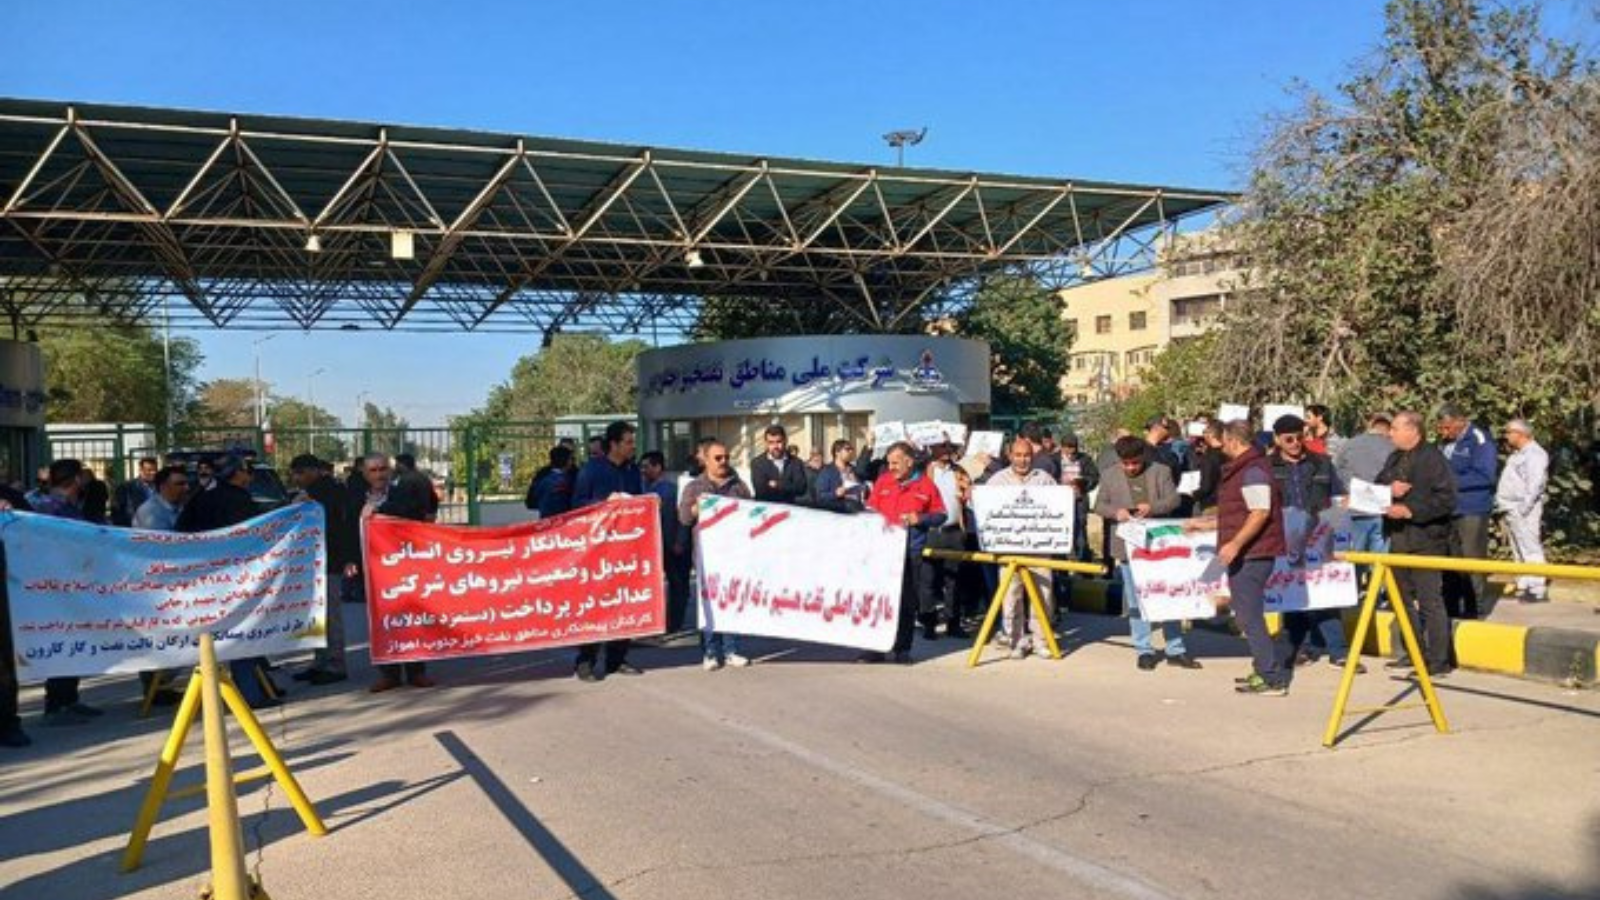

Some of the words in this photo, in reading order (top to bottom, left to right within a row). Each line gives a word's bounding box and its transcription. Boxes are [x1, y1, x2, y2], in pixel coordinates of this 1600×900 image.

[729, 358, 787, 389] مناطق
[792, 355, 831, 385] ملی
[837, 355, 896, 390] شرکت
[521, 533, 587, 559] پیمانکار
[589, 526, 646, 545] حذف
[381, 541, 442, 567] انسانی
[446, 539, 515, 564] نیروی
[527, 561, 589, 587] وضعیت
[592, 553, 639, 581] تبدیل
[641, 559, 651, 576] و
[381, 572, 446, 600] شرکتی
[449, 567, 523, 596] نیروهای
[576, 595, 597, 617] در
[599, 587, 653, 608] عدالت
[769, 587, 801, 617] هستیم
[803, 586, 824, 613] نفت
[439, 606, 495, 628] (دستمزد
[500, 598, 571, 621] پرداخت
[383, 612, 437, 630] عادلانه)
[611, 612, 653, 630] کارکنان
[156, 634, 189, 651] ارکان
[387, 638, 421, 654] اهواز
[422, 638, 459, 651] جنوب
[484, 632, 511, 643] نفت
[25, 640, 65, 659] کارون
[90, 644, 98, 656] و
